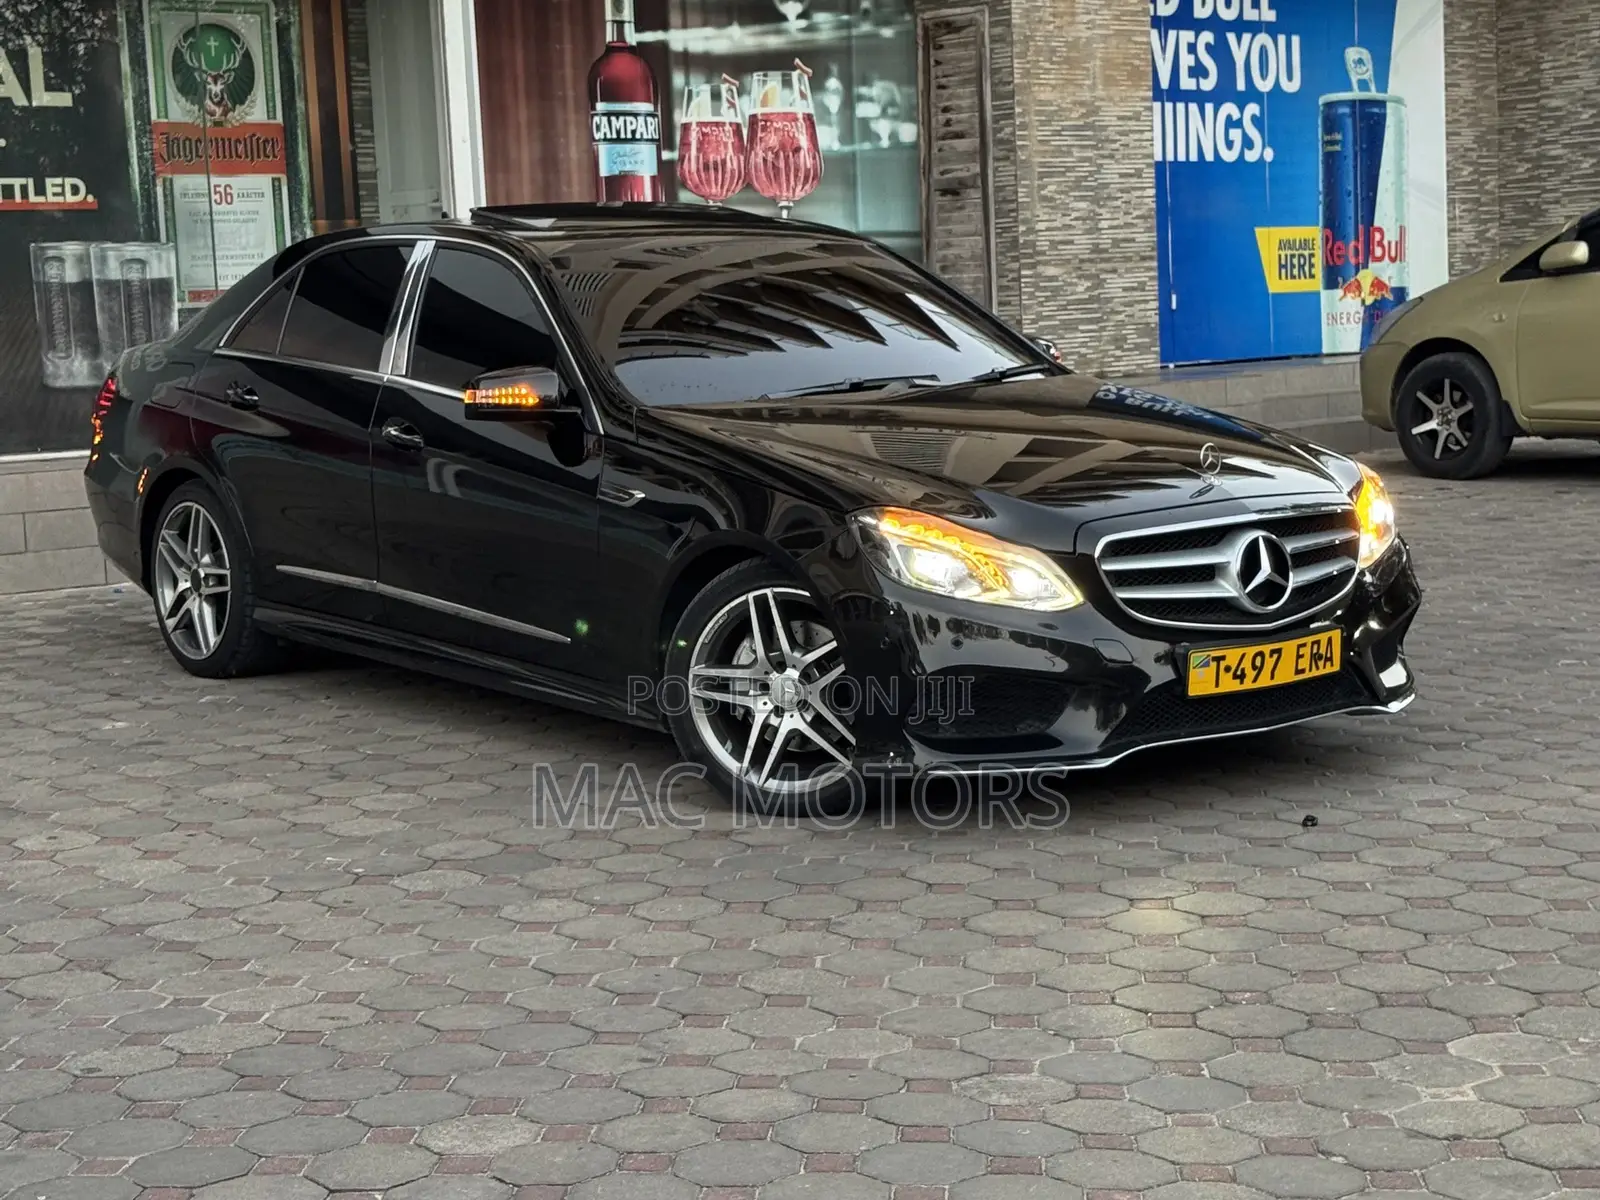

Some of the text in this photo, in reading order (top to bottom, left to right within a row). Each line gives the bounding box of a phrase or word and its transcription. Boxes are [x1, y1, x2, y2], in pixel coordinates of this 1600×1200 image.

[1225, 31, 1301, 93] YOU
[592, 115, 660, 140] CAMPARI
[213, 183, 234, 206] 56
[1277, 237, 1316, 252] AVAILABLE
[1322, 223, 1407, 267] Red Bull
[1277, 252, 1316, 280] HERE
[1326, 310, 1369, 327] ENERG
